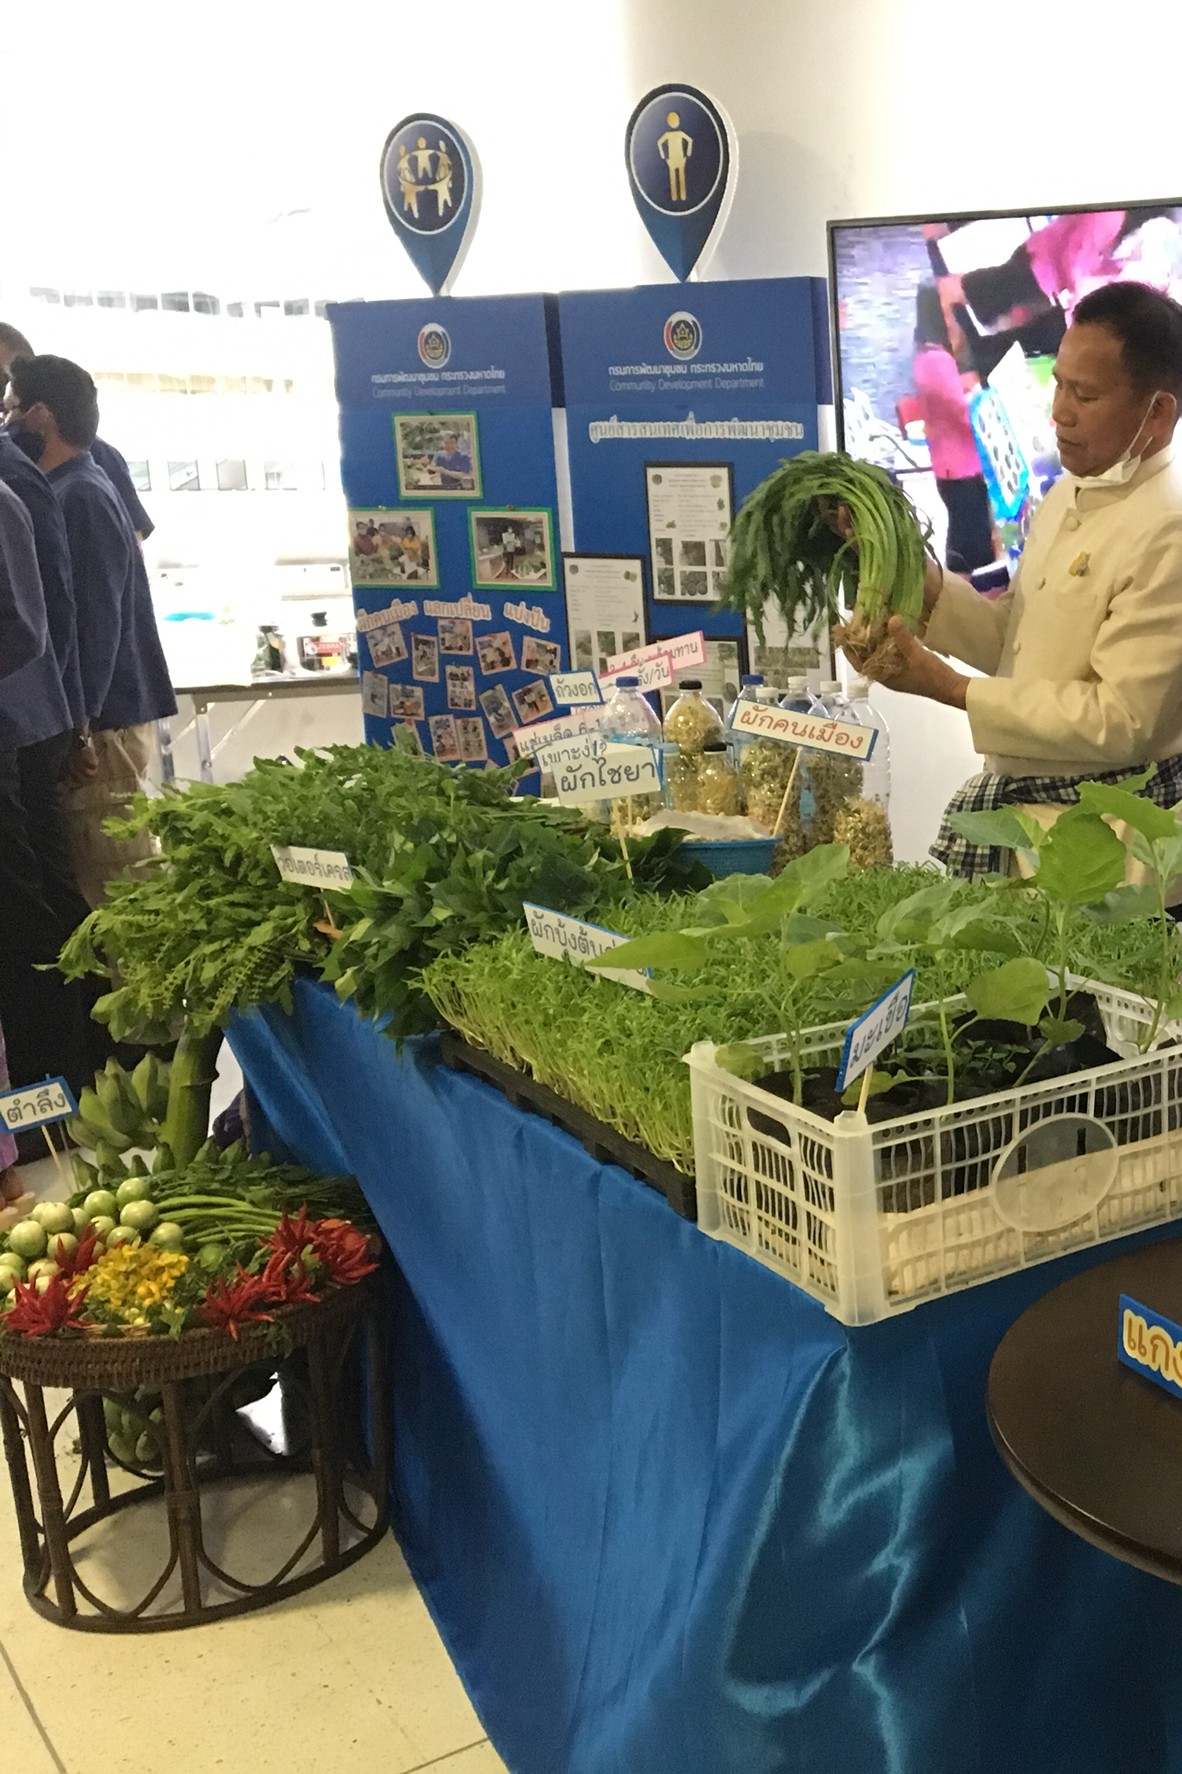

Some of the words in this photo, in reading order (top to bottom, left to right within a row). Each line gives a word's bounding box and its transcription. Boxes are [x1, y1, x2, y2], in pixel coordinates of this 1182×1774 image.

[373, 386, 412, 399] Community
[414, 385, 461, 397] Development
[463, 384, 506, 395] Department
[609, 380, 656, 393] Community
[658, 379, 713, 392] Development
[715, 378, 765, 390] Department
[740, 705, 864, 749] ผักคนเมือง
[560, 757, 656, 792] ผักไชยา
[6, 1089, 66, 1124] ตำลึง
